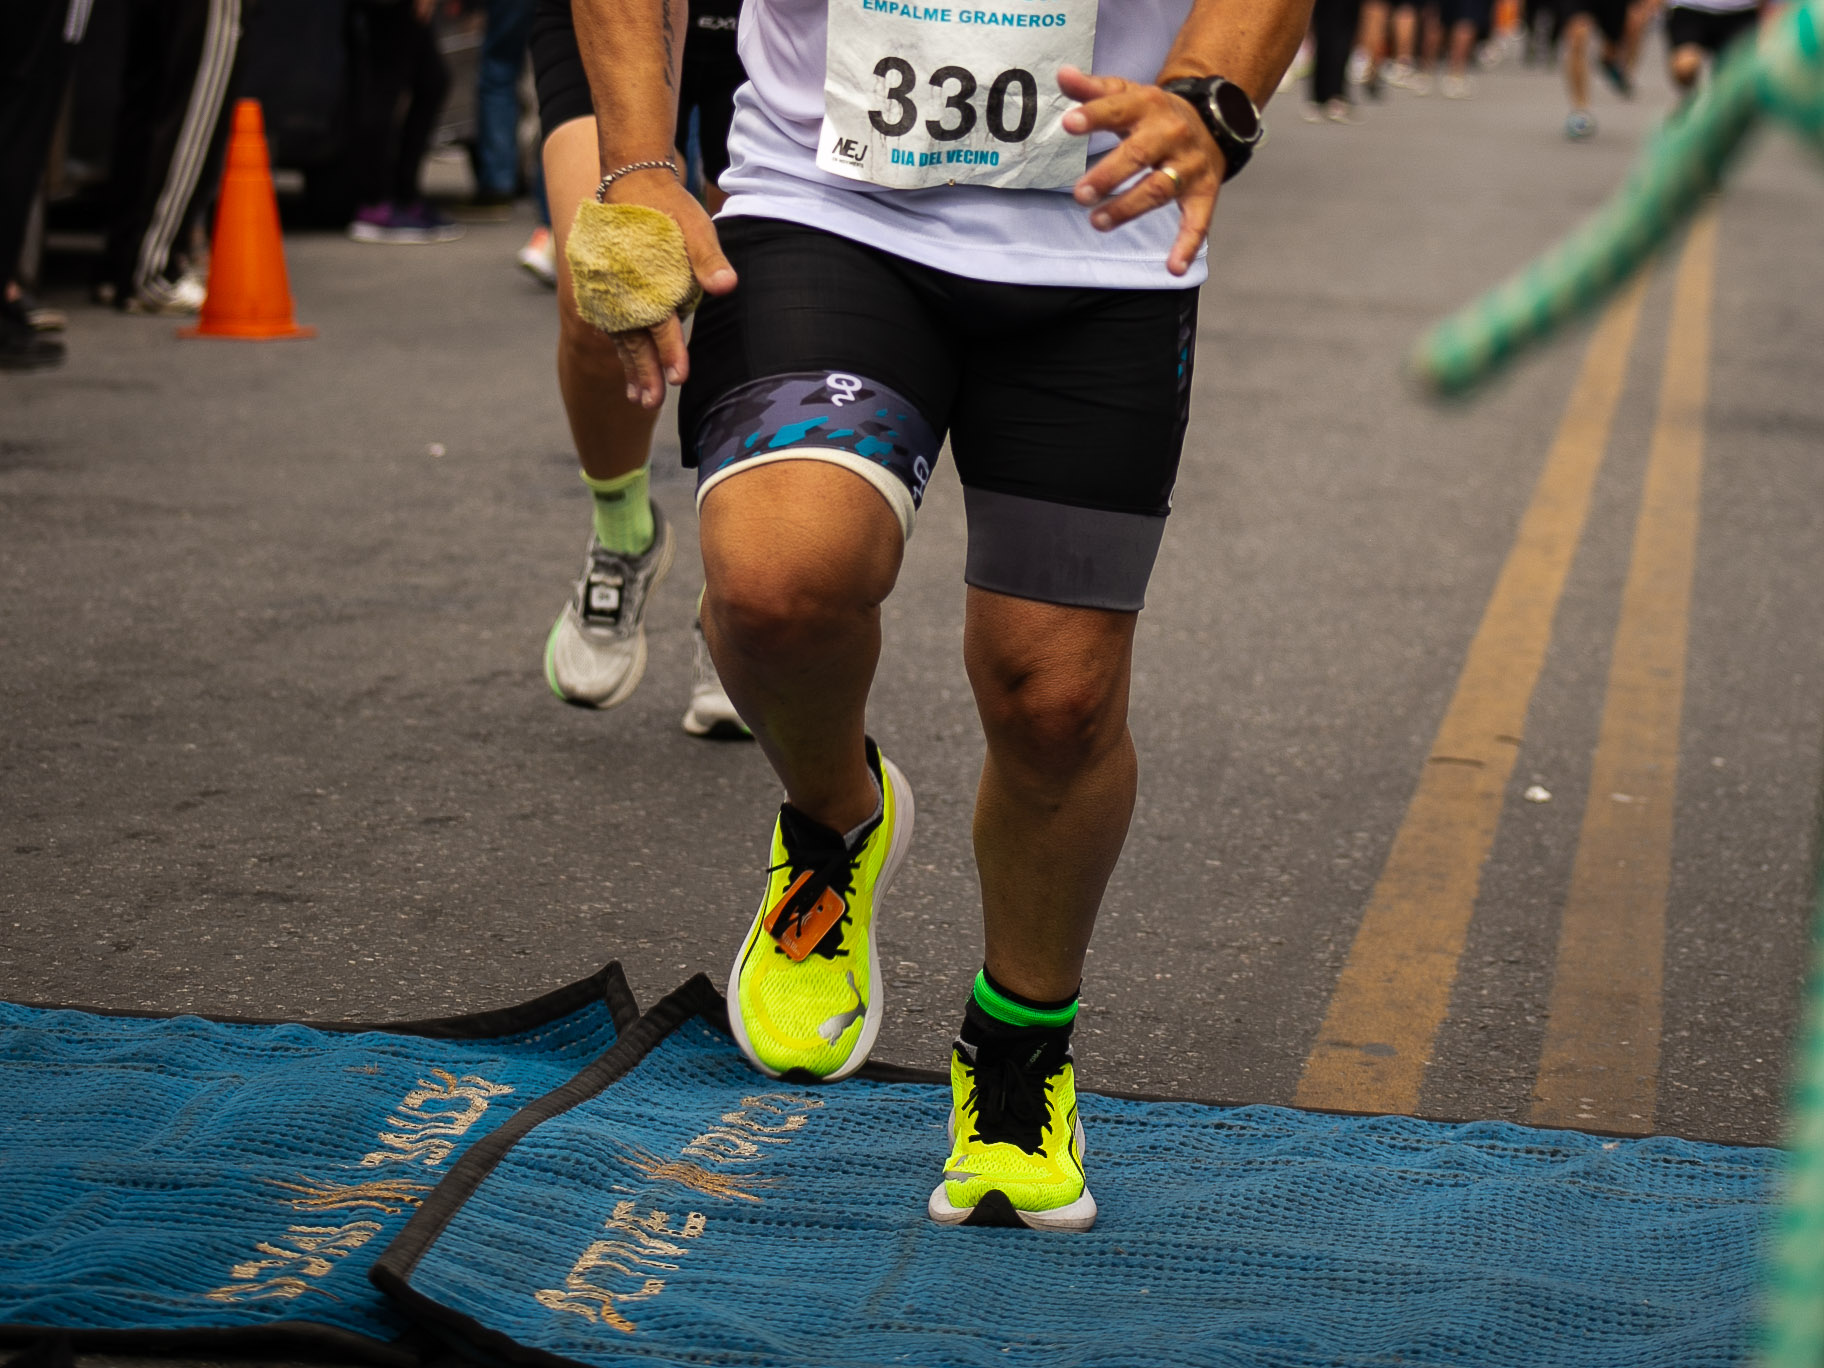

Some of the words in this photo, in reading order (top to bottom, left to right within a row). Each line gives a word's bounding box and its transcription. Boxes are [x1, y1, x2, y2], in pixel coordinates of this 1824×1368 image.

[958, 9, 1067, 28] GRANEROS
[867, 56, 1038, 144] 330
[831, 136, 869, 162] NEJ
[891, 148, 915, 167] DIA
[918, 150, 943, 167] DEL
[945, 148, 1000, 167] VECINO
